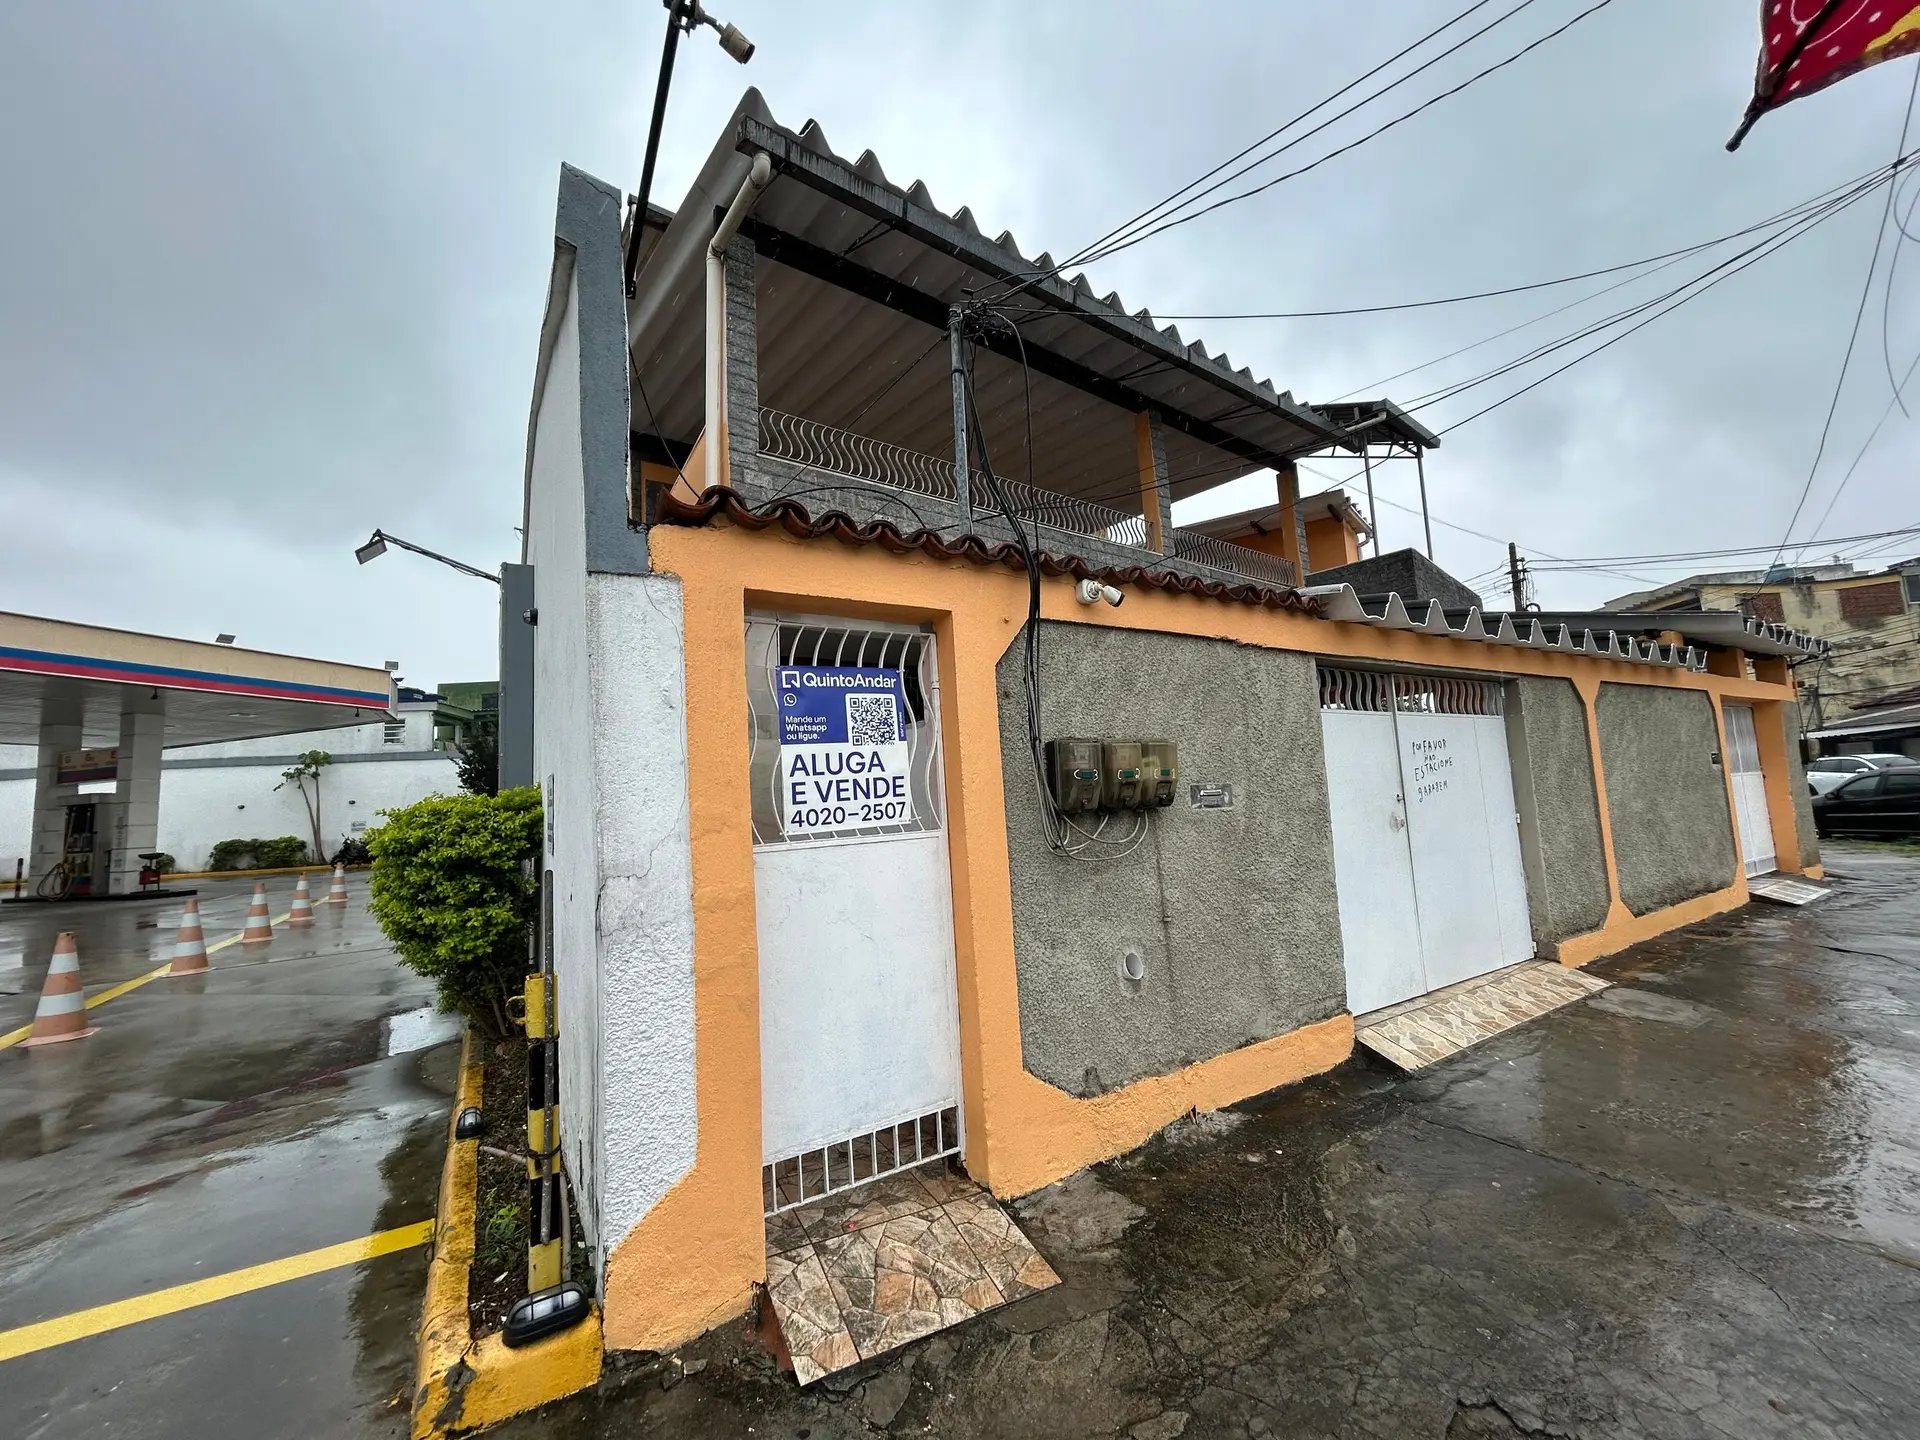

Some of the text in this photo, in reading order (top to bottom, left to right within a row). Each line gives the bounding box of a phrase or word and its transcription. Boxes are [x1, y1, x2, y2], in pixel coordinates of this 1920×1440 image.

[803, 673, 896, 688] QuintoAndar
[785, 715, 813, 723] Mande
[786, 724, 827, 732] Whatsapp
[798, 732, 820, 740] ligue.
[1423, 738, 1447, 752] FAVOR
[790, 751, 885, 777] ALUGA
[791, 776, 905, 805] E VENDE
[791, 802, 906, 827] 4020-2507
